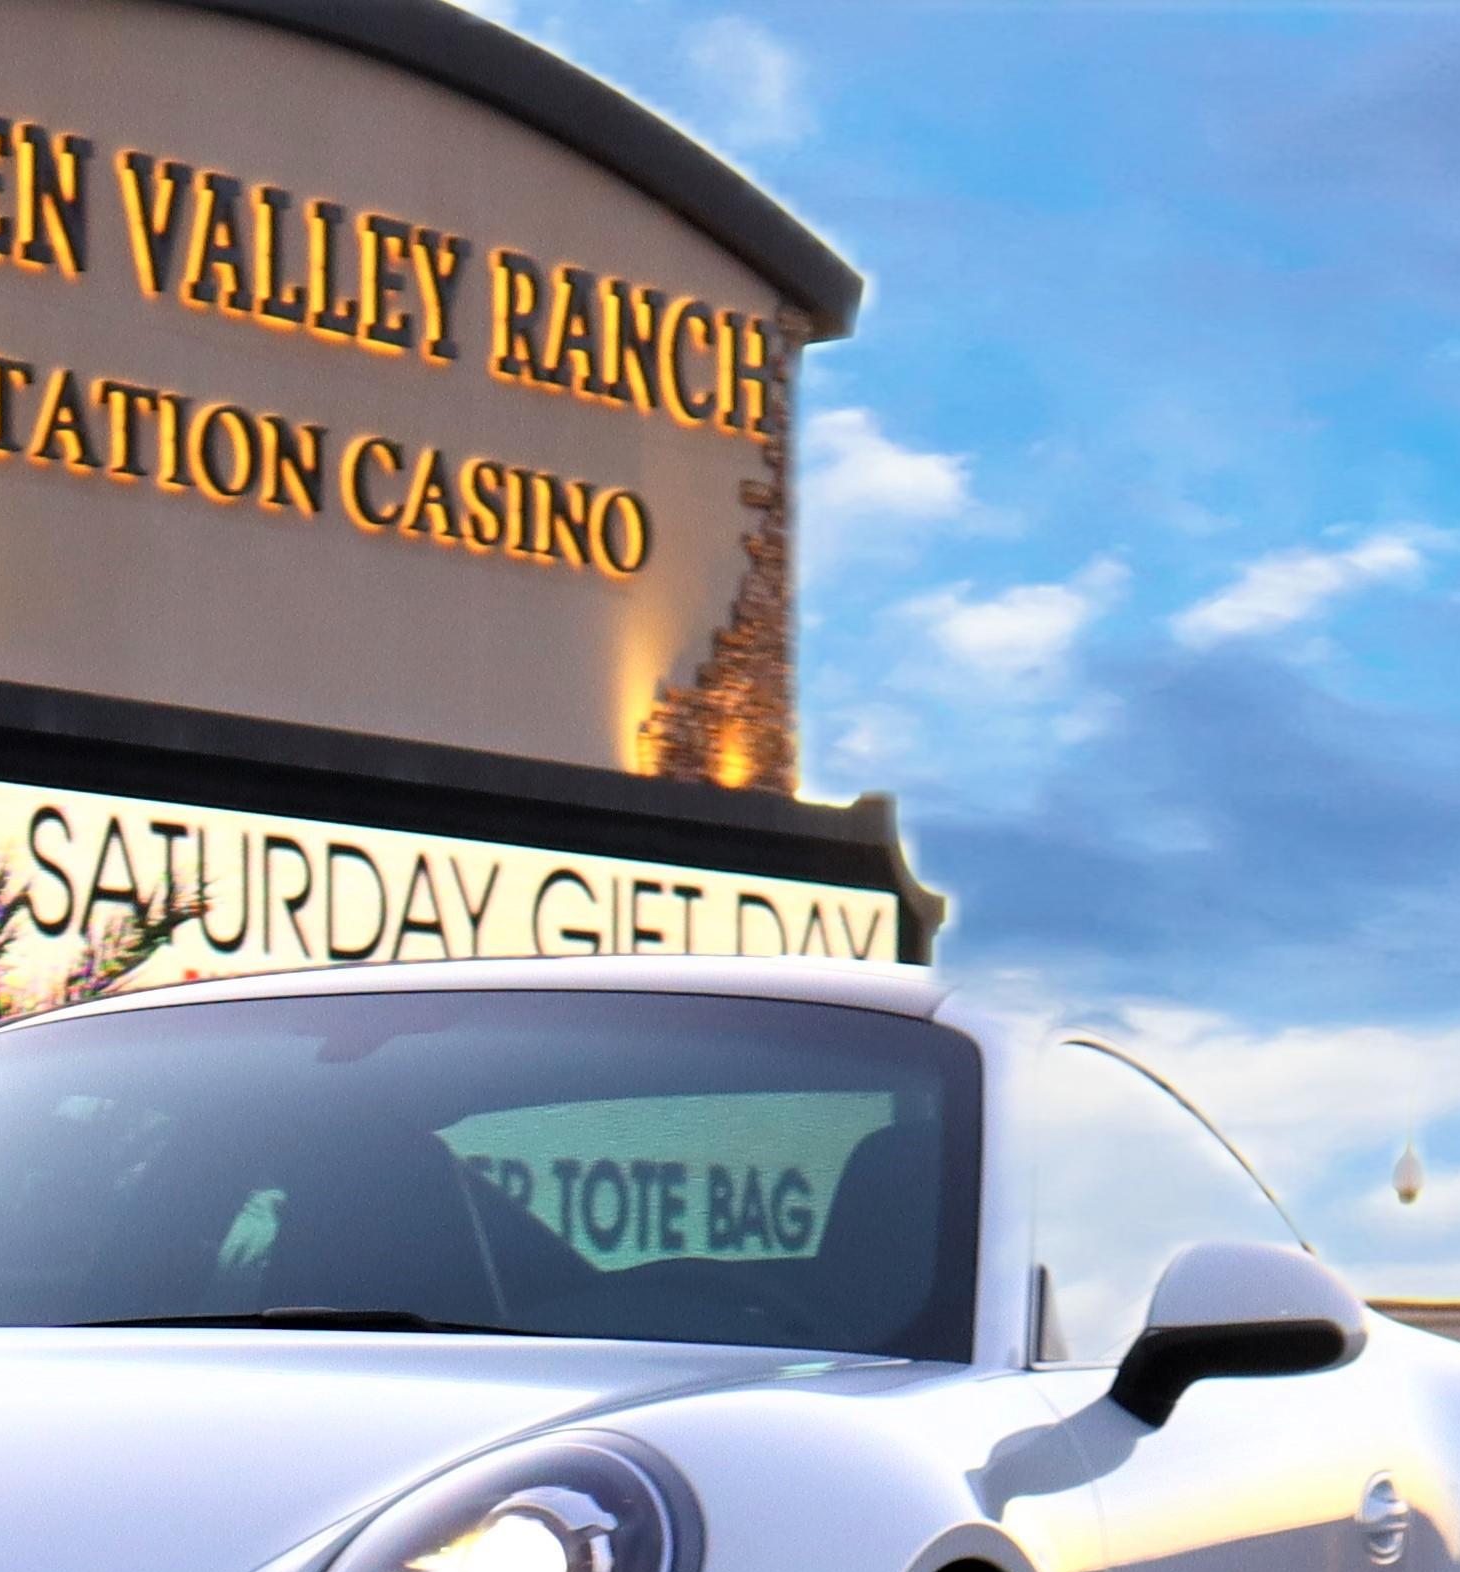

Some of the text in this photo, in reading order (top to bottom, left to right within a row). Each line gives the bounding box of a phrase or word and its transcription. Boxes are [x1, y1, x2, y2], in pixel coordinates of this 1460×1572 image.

[120, 150, 470, 361] VALLEY
[490, 248, 786, 438] RANCH
[342, 434, 652, 576] CASINO
[25, 804, 882, 962] SATURDAY GIFT DAY
[552, 1157, 688, 1253] TOTE
[705, 1163, 815, 1251] BAG
